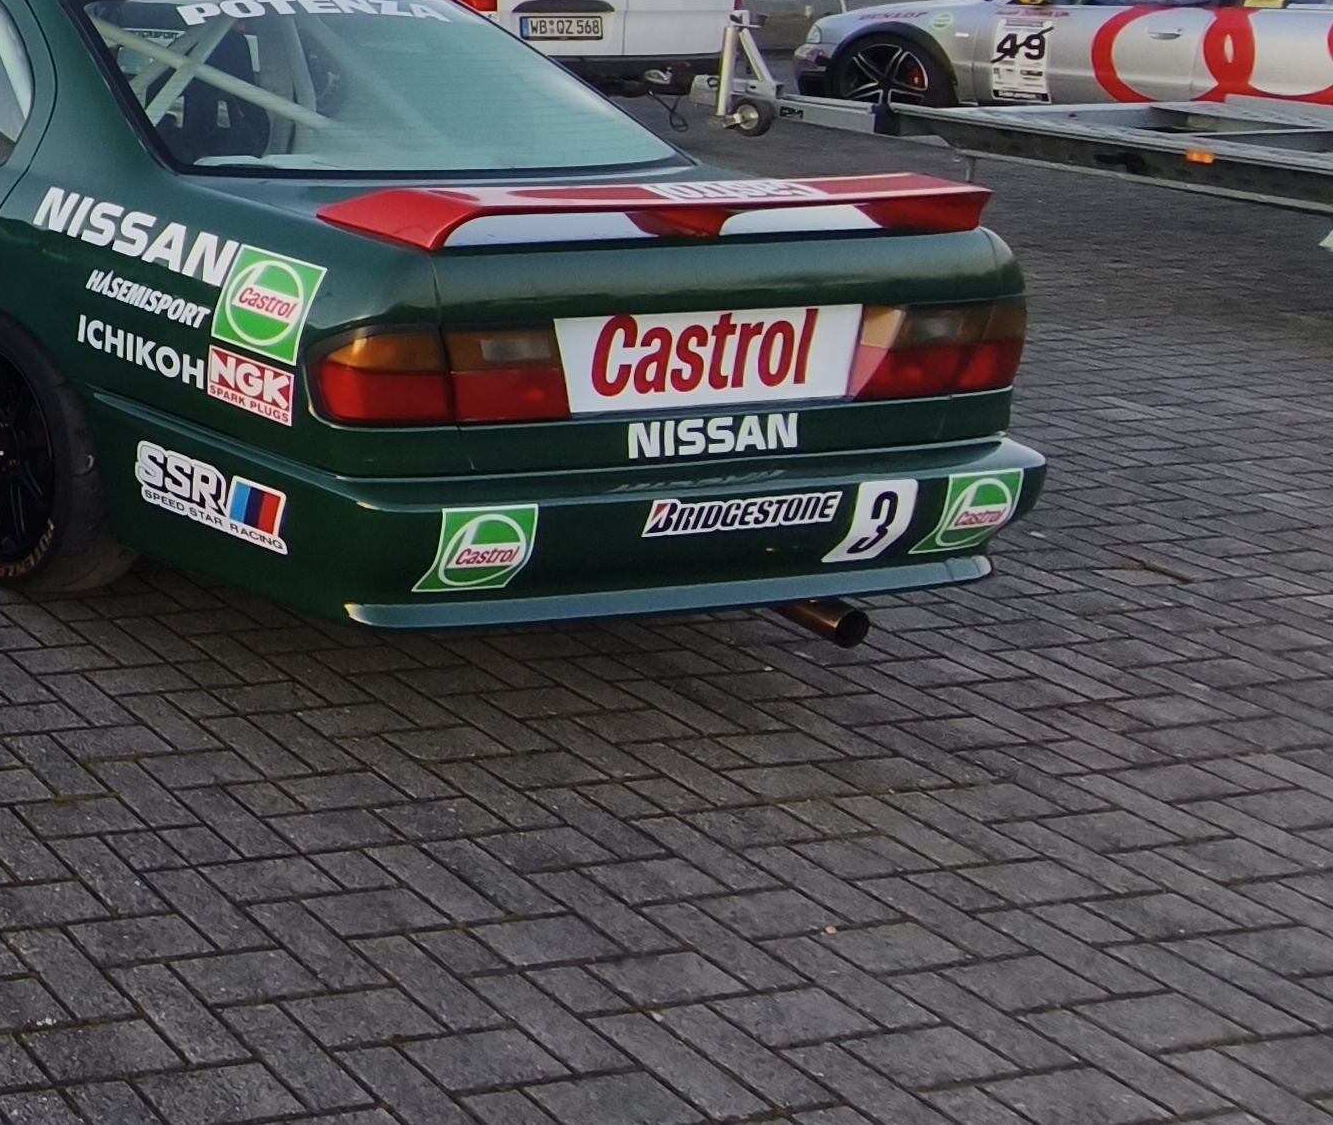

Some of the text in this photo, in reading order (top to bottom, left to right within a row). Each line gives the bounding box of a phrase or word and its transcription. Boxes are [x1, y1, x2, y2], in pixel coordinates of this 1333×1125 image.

[529, 19, 600, 35] WB QZ 568
[995, 32, 1047, 61] 49
[33, 186, 239, 287] NISSAN
[86, 269, 211, 329] HASEMISPORT
[238, 286, 299, 319] Castrol
[77, 314, 205, 390] ICHIKOH
[591, 307, 819, 398] Castrol
[209, 384, 290, 423] SPARK PLUGS
[210, 353, 291, 409] NGK
[628, 413, 799, 459] NISSAN
[136, 444, 223, 513] SSR
[144, 488, 284, 550] SPEED STAR RACING
[648, 496, 836, 533] BRIDGESTONE
[847, 491, 900, 555] 3
[953, 506, 1006, 527] Castrol
[454, 545, 520, 566] Castrol
